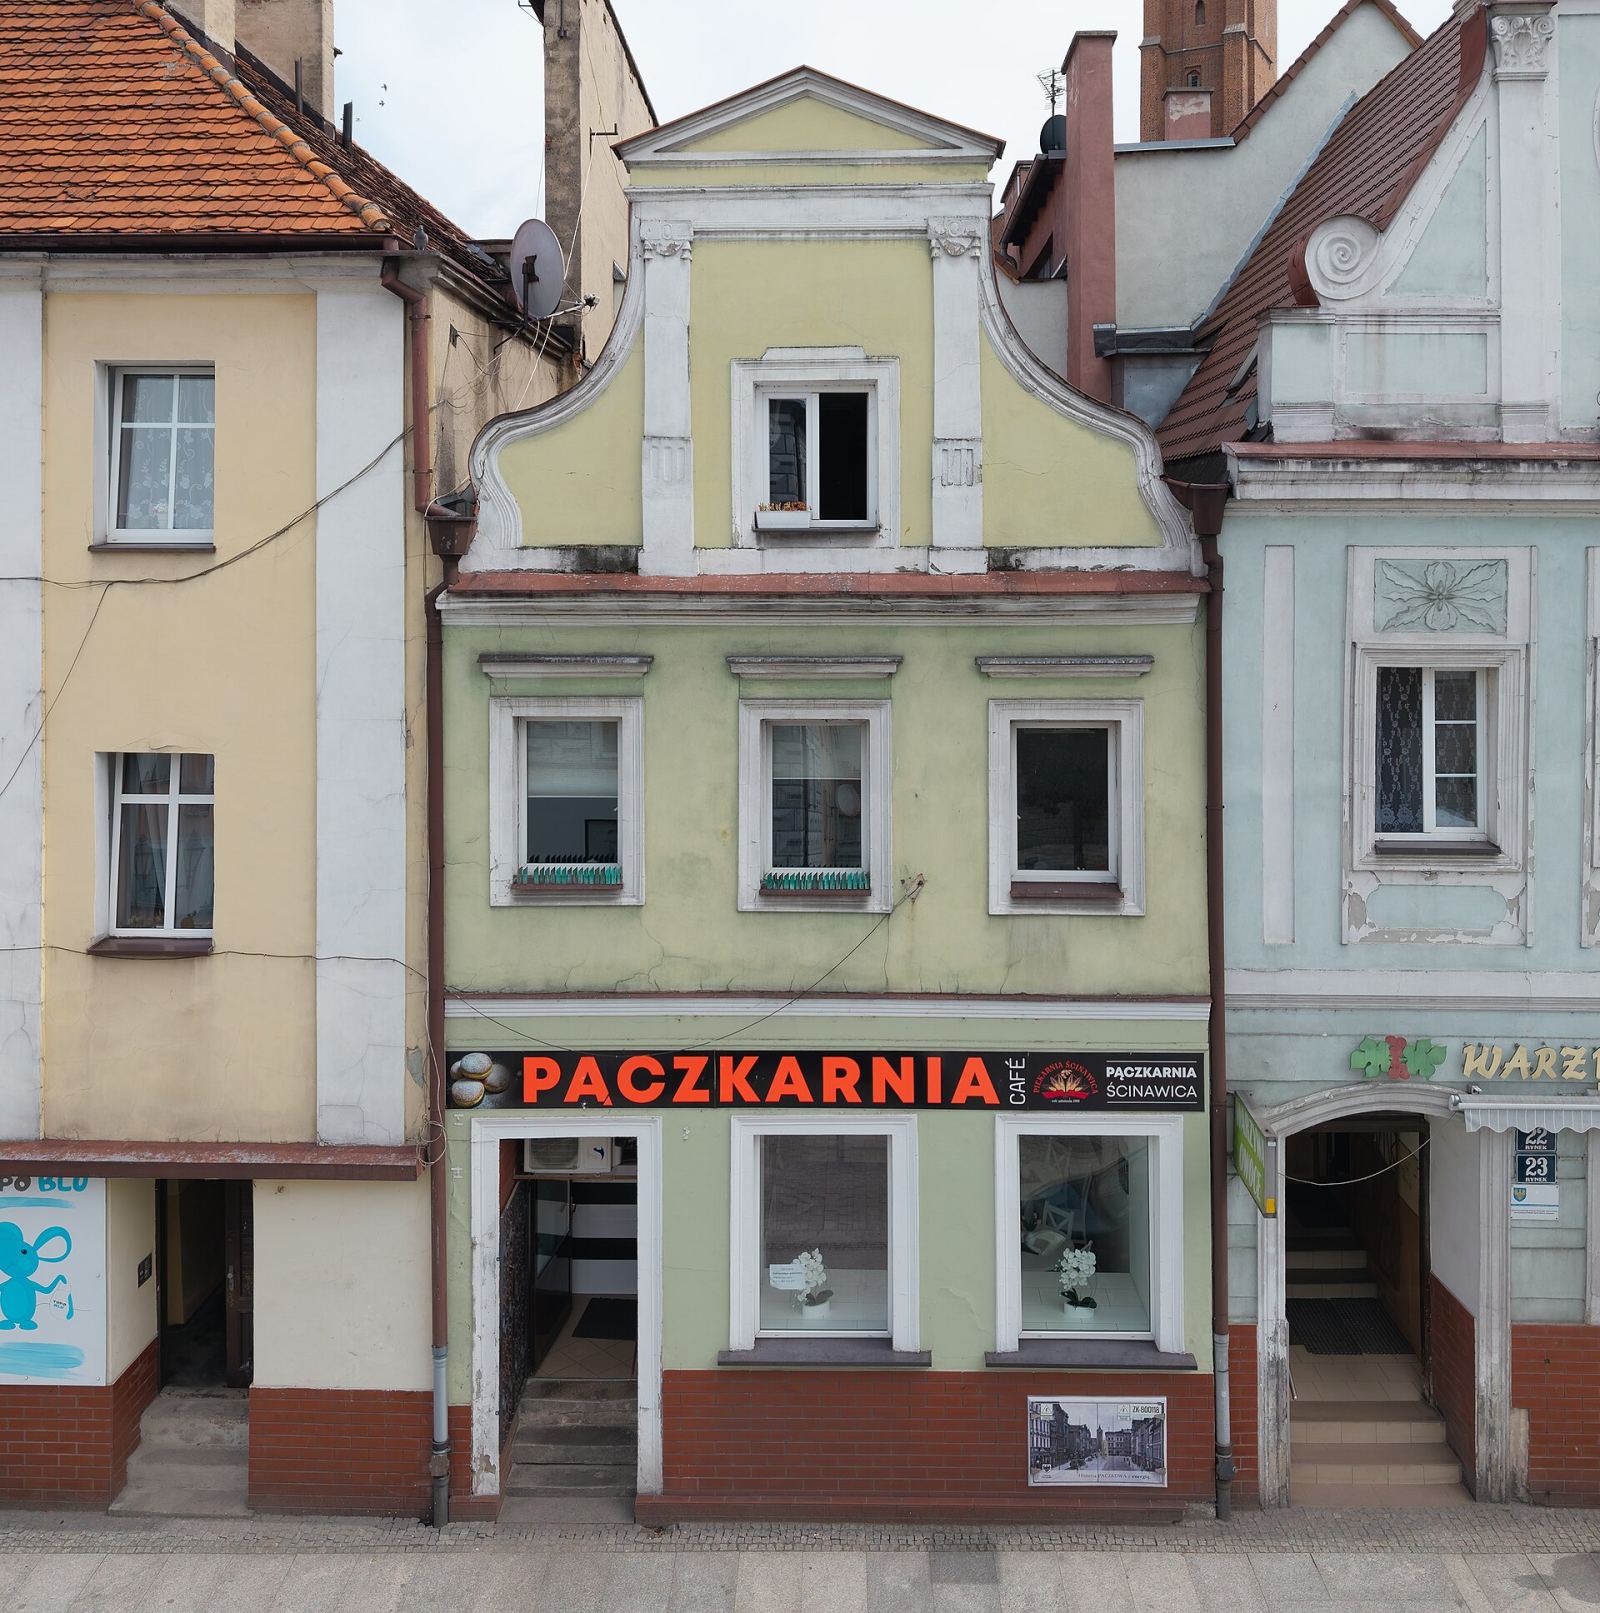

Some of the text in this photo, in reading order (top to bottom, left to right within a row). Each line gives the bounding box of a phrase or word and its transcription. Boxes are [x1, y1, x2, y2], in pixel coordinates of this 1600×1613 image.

[523, 1055, 1000, 1106] PĄCZKARNIA
[1005, 1056, 1026, 1105] CAFÉ
[1032, 1059, 1099, 1095] PIEKARNIA ŚCINAWICA
[1105, 1065, 1198, 1081] PĄCZKARNIA
[1106, 1082, 1198, 1098] ŚCINAWICA
[1525, 1126, 1548, 1145] 22
[1525, 1157, 1548, 1176] 23
[38, 1176, 88, 1192] BLU
